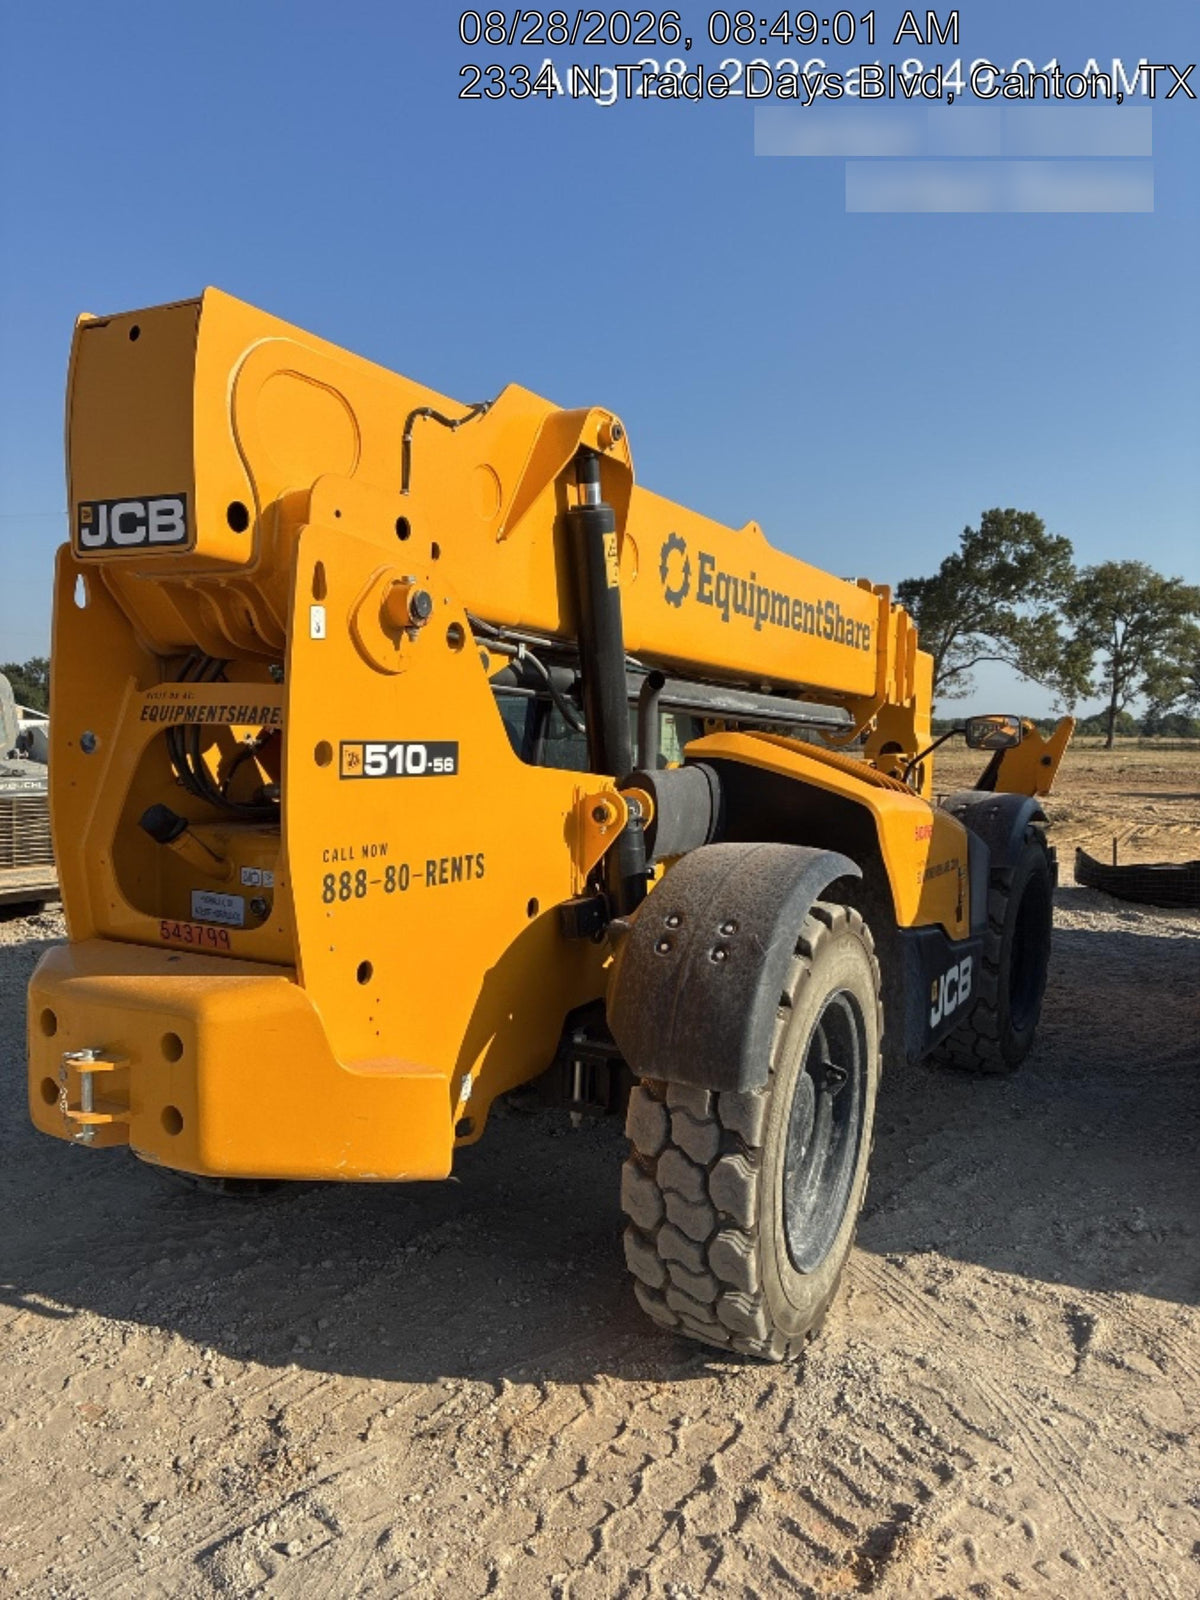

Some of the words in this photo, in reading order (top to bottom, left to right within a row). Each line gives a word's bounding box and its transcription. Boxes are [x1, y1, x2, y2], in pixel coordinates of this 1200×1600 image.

[81, 499, 185, 547] JCB
[696, 551, 871, 651] EquipmentShare
[322, 846, 355, 863] CALL
[362, 843, 388, 859] NOW
[322, 853, 485, 904] 888-80-RENTS
[160, 921, 231, 950] 543799
[930, 956, 973, 1029] JCB
